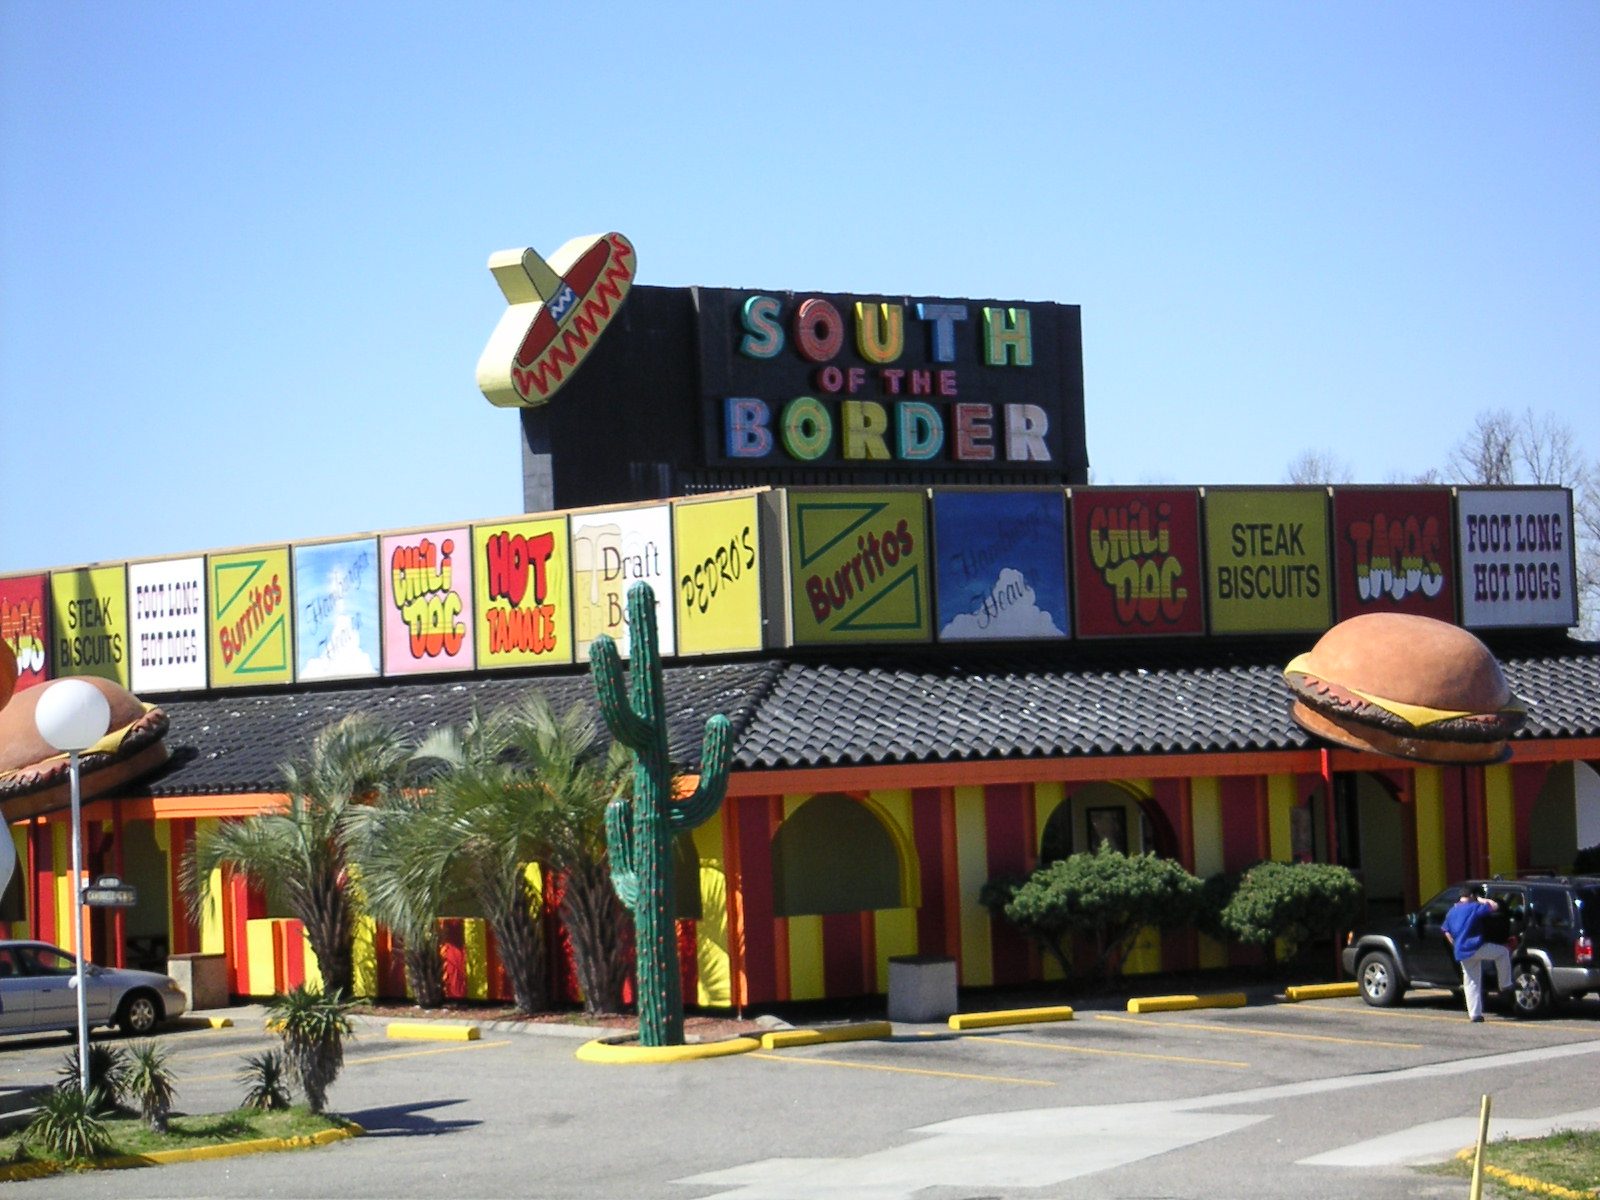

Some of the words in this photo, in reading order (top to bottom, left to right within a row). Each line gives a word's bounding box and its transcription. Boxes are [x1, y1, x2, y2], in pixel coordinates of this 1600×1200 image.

[740, 295, 1033, 367] SOUTH
[817, 366, 865, 393] OF
[880, 369, 959, 396] THE
[724, 396, 1052, 461] BORDER
[1232, 522, 1305, 558] STEAK
[1466, 514, 1511, 553] FOOT
[1516, 514, 1563, 553] LONG
[486, 530, 555, 607] HOT
[602, 541, 662, 582] Draft
[681, 526, 756, 618] PEDRO'S
[805, 518, 914, 625] Burritos
[1346, 512, 1444, 603] TACOS
[136, 583, 165, 620] FOOT
[168, 580, 199, 617] LONG
[1217, 564, 1321, 600] BISCUITS
[1473, 563, 1512, 602] HOT
[1516, 563, 1562, 601] DOGS
[68, 597, 113, 629] STEAK
[219, 573, 283, 669] Burritos
[486, 603, 557, 656] TAMALE
[60, 634, 122, 668] BISCUITS
[140, 631, 164, 668] HOT
[167, 628, 198, 665] DOGS
